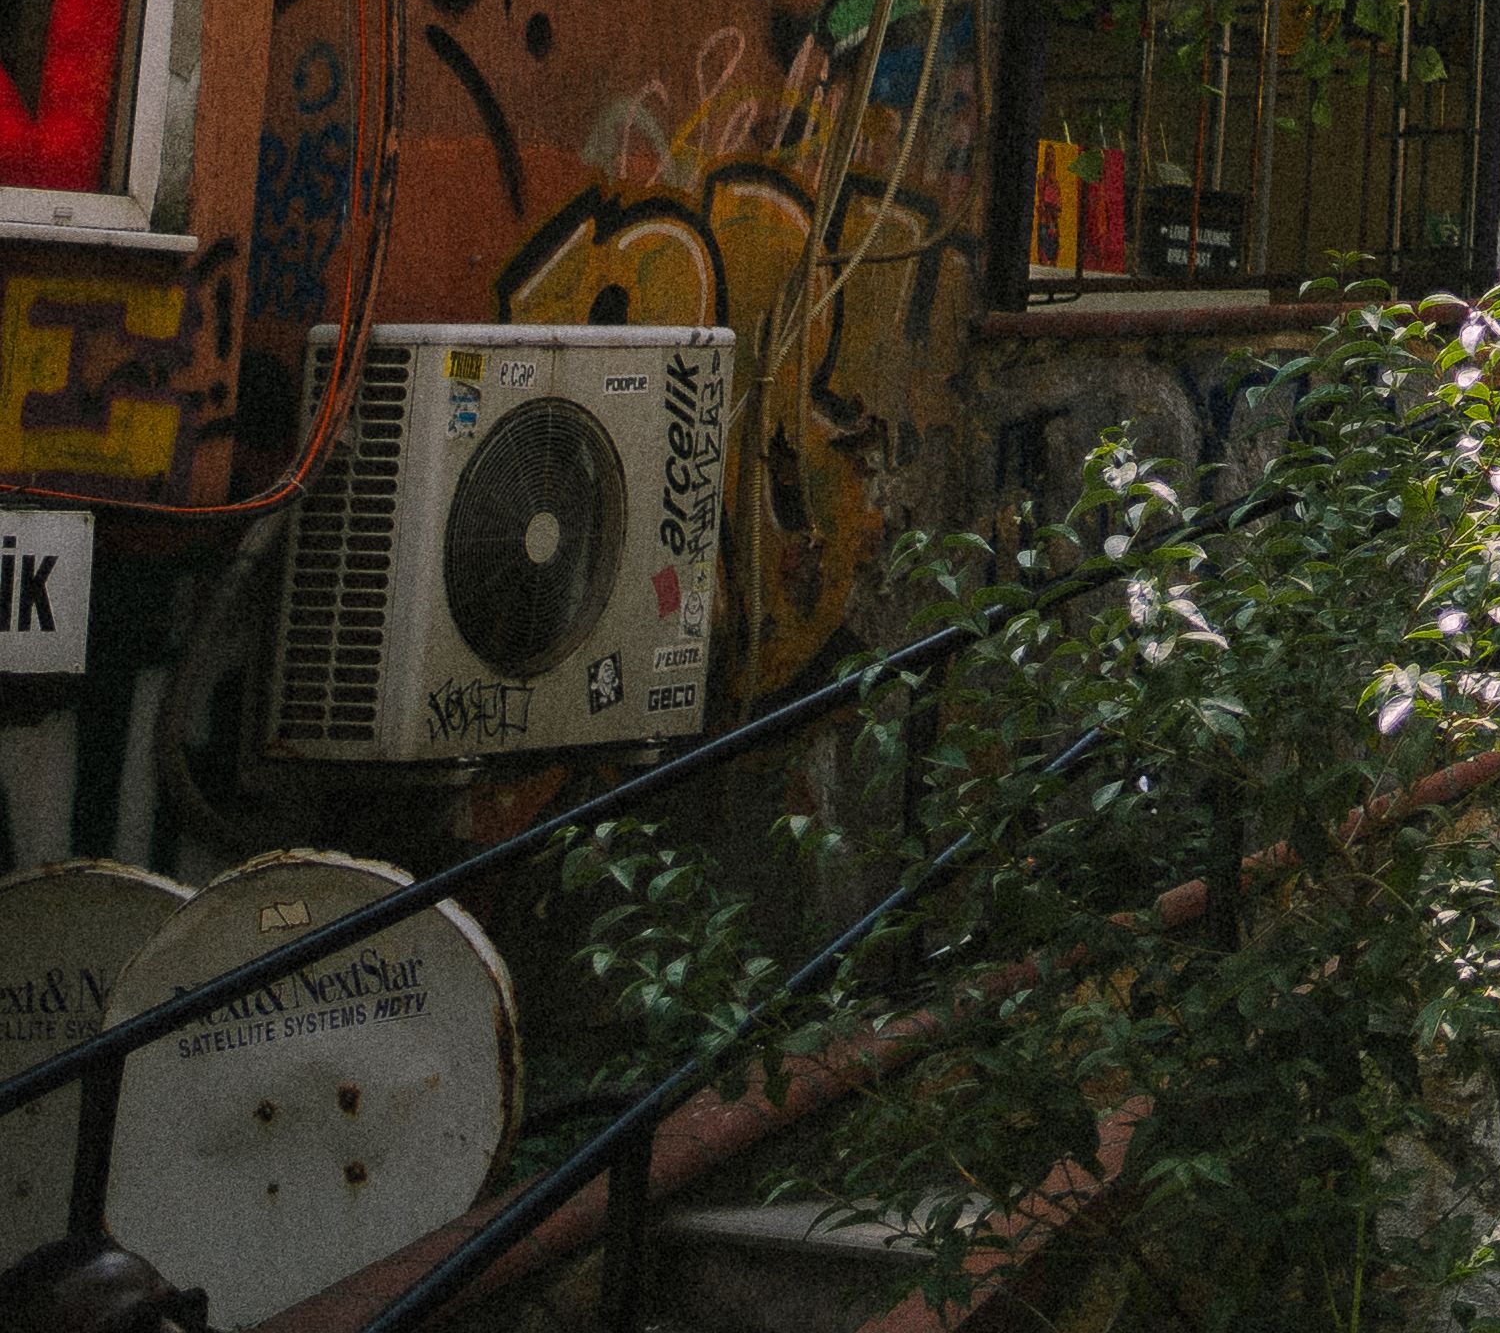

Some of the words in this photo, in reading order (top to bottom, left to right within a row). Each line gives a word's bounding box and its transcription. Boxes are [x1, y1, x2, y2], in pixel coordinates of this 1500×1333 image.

[290, 948, 424, 1007] NextStar
[178, 1022, 277, 1058] SATELLITE
[283, 1005, 368, 1037] SYSTEMS
[372, 992, 429, 1021] HDTV
